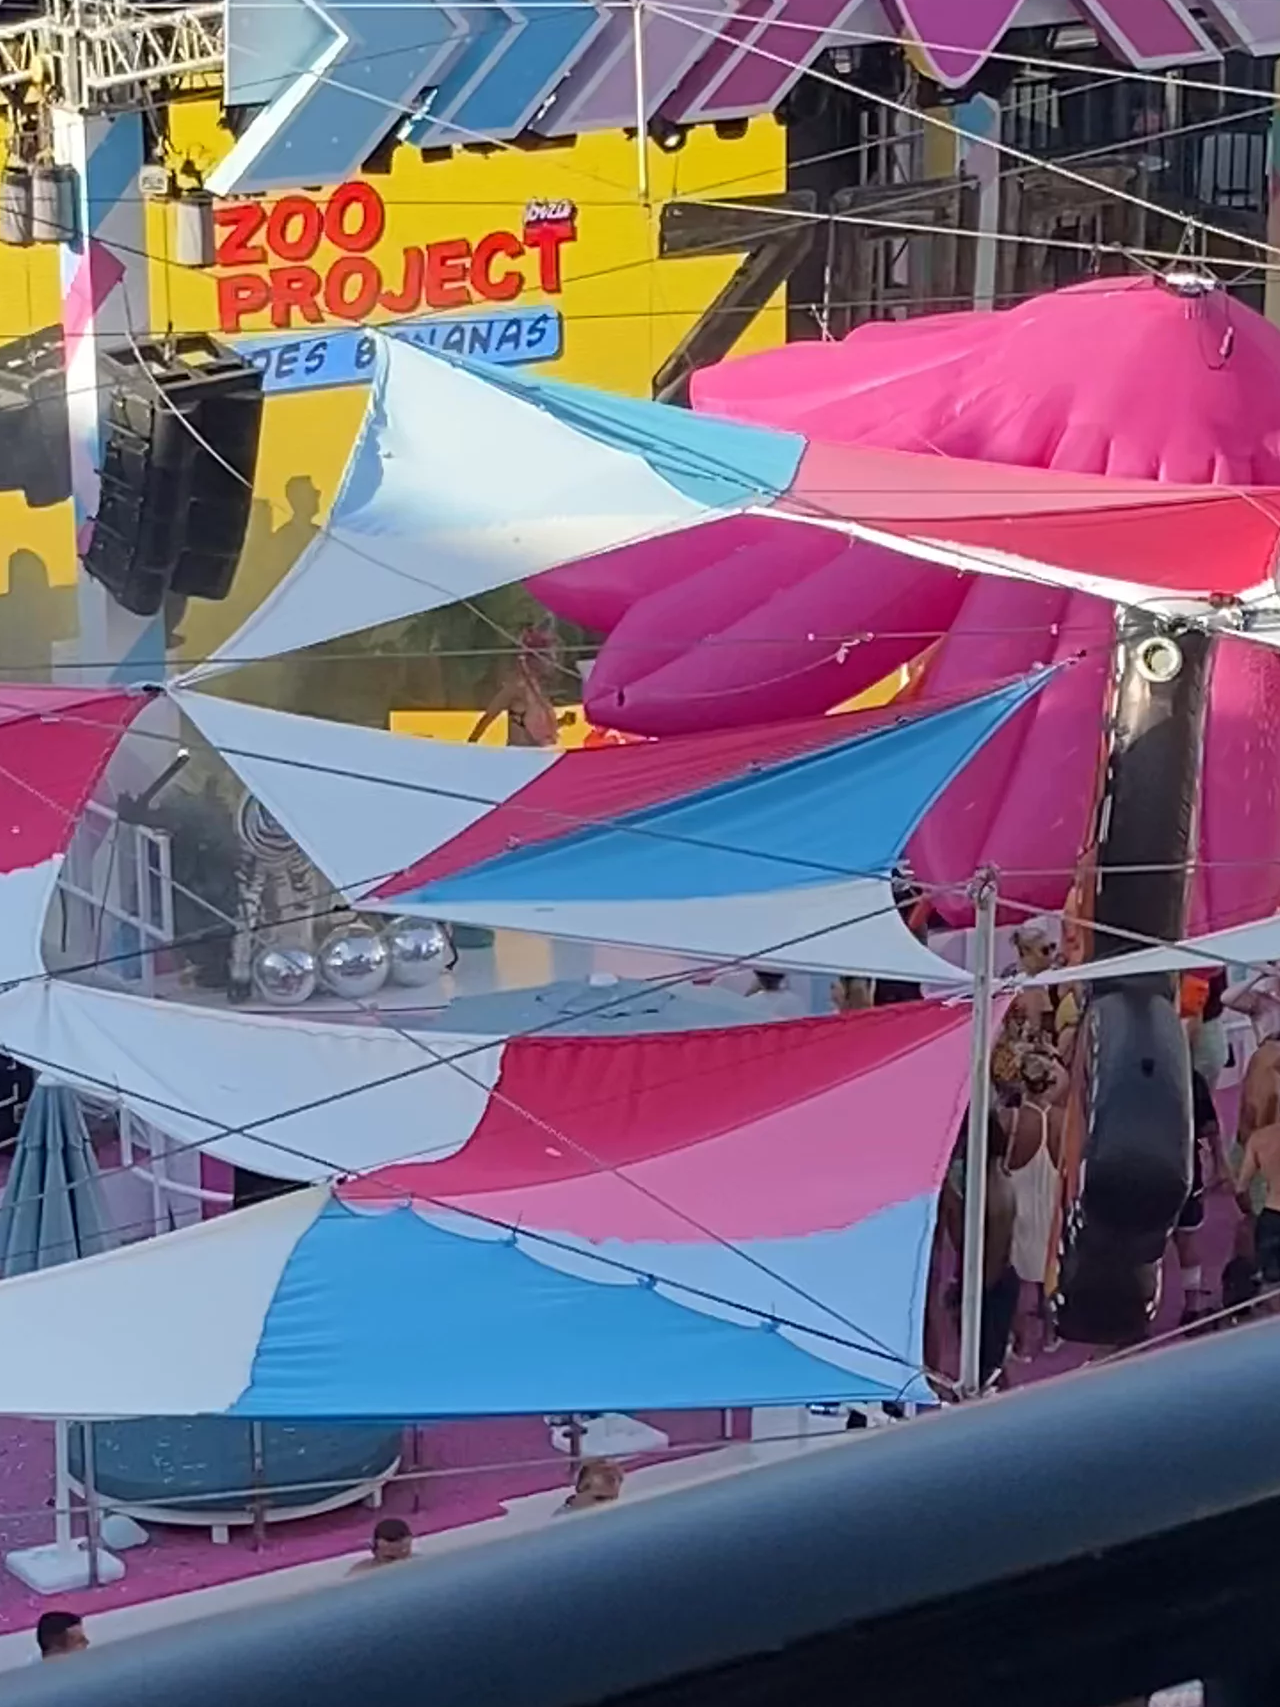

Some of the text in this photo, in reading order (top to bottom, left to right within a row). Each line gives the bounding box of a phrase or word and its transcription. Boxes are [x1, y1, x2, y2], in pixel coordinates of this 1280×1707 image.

[213, 180, 385, 266] ZOO
[216, 221, 579, 334] PROJECT
[247, 313, 551, 380] OES BANAS
